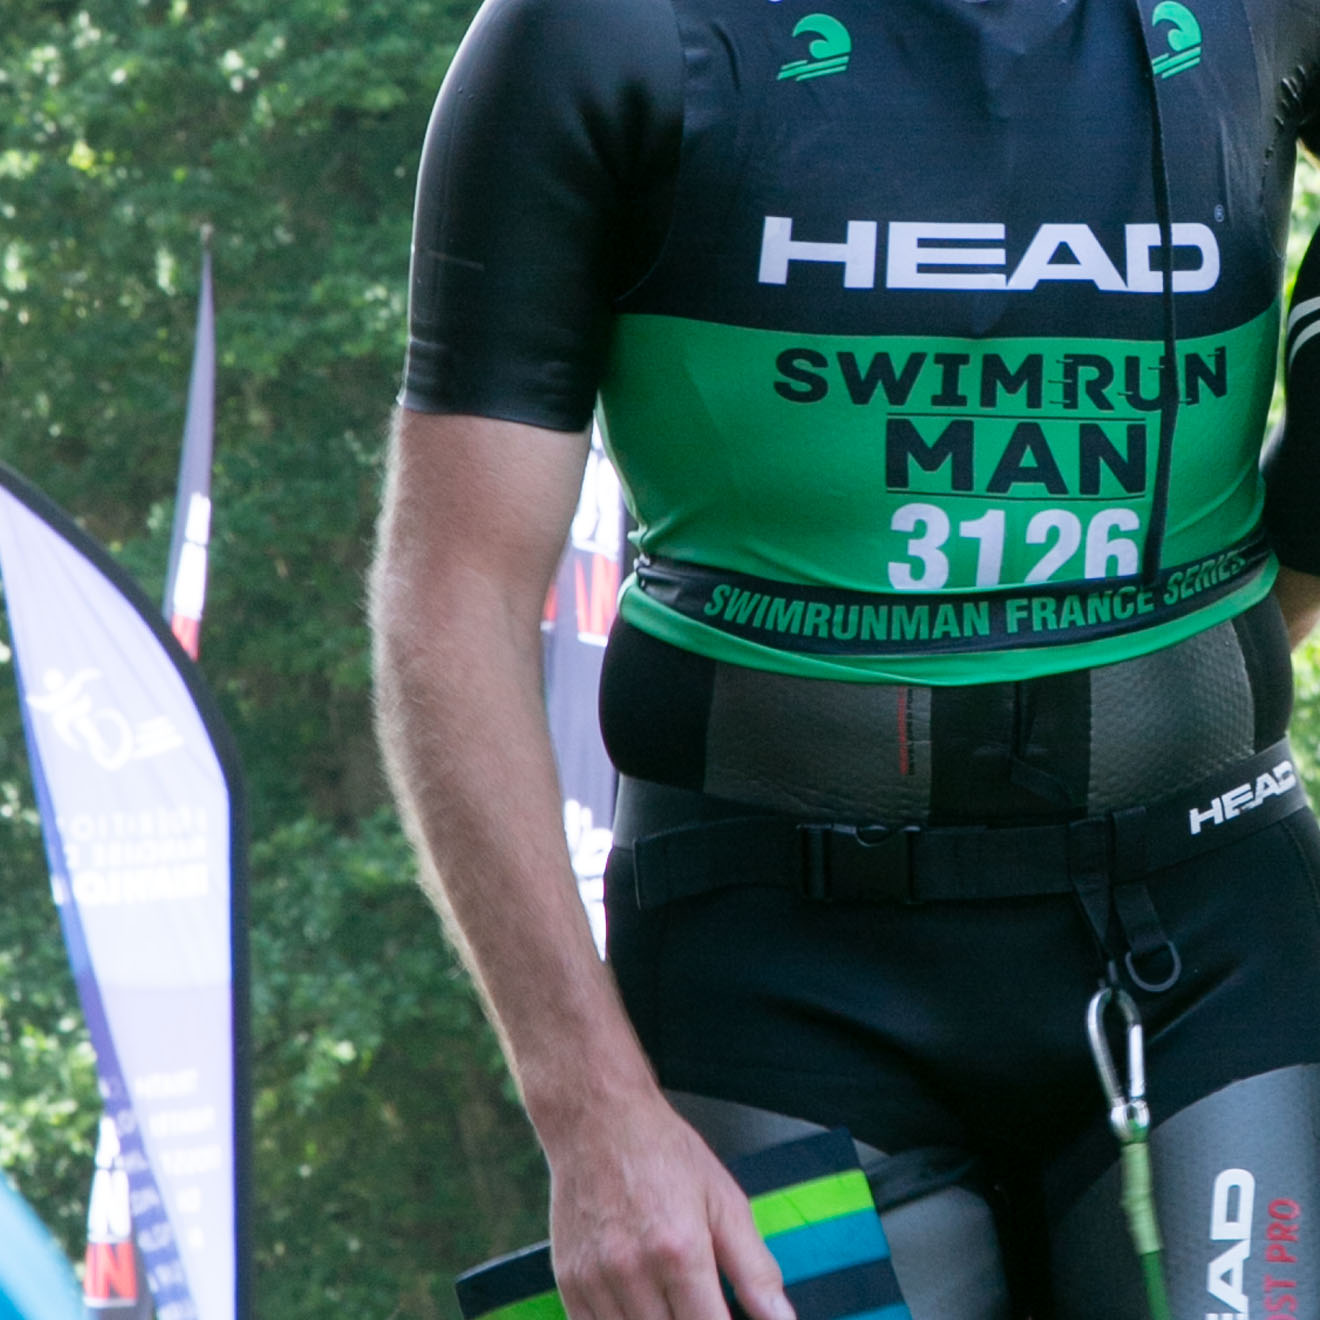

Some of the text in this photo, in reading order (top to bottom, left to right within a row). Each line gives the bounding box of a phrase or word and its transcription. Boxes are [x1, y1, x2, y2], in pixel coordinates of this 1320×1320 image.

[758, 216, 1221, 293] HEAD
[773, 346, 1227, 412] SWIMRUN
[885, 419, 1146, 496] MAN
[887, 503, 1141, 590] 3126
[703, 583, 990, 641] SWIMRUNMAN
[1006, 587, 1155, 635] FRANCE
[1189, 760, 1297, 835] HEAD
[1265, 1197, 1302, 1264] PRO
